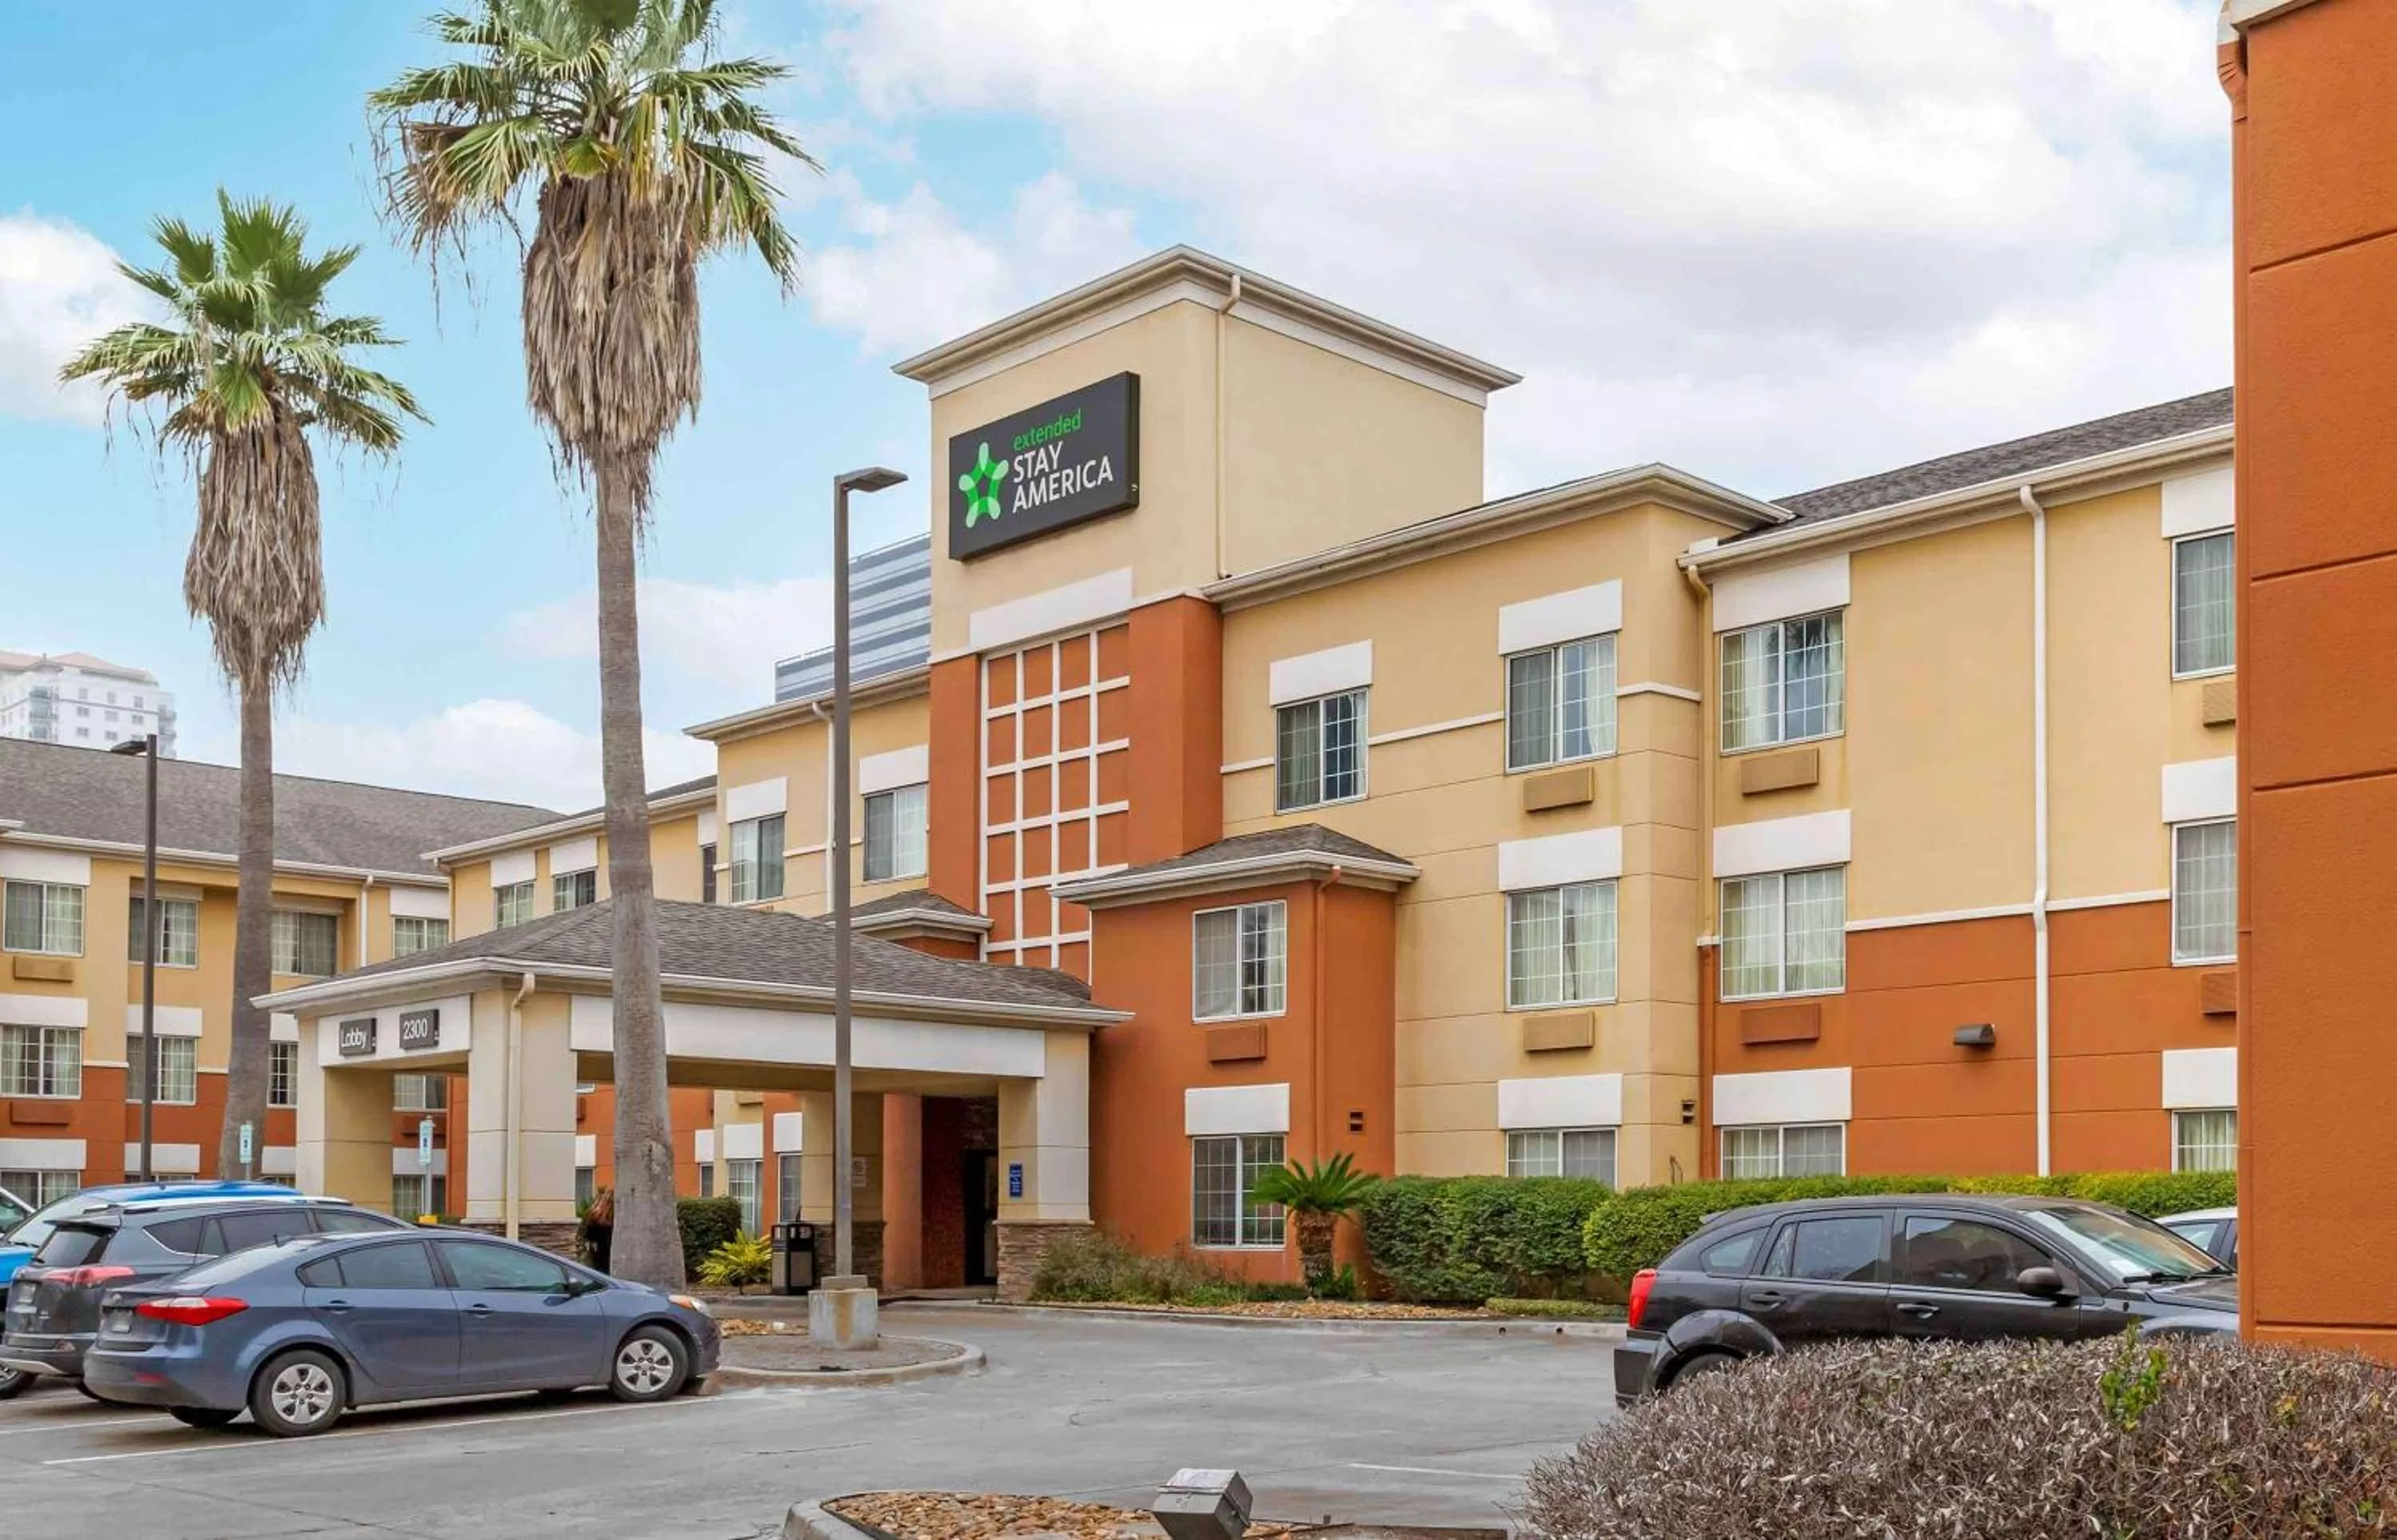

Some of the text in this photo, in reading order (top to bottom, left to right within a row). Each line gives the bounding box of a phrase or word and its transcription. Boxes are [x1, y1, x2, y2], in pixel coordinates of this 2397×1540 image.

[1013, 408, 1081, 451] extended
[1013, 441, 1063, 483] STAY
[1012, 455, 1113, 513] AMERICA
[340, 1026, 367, 1048] Lobby
[403, 1018, 428, 1039] 2300
